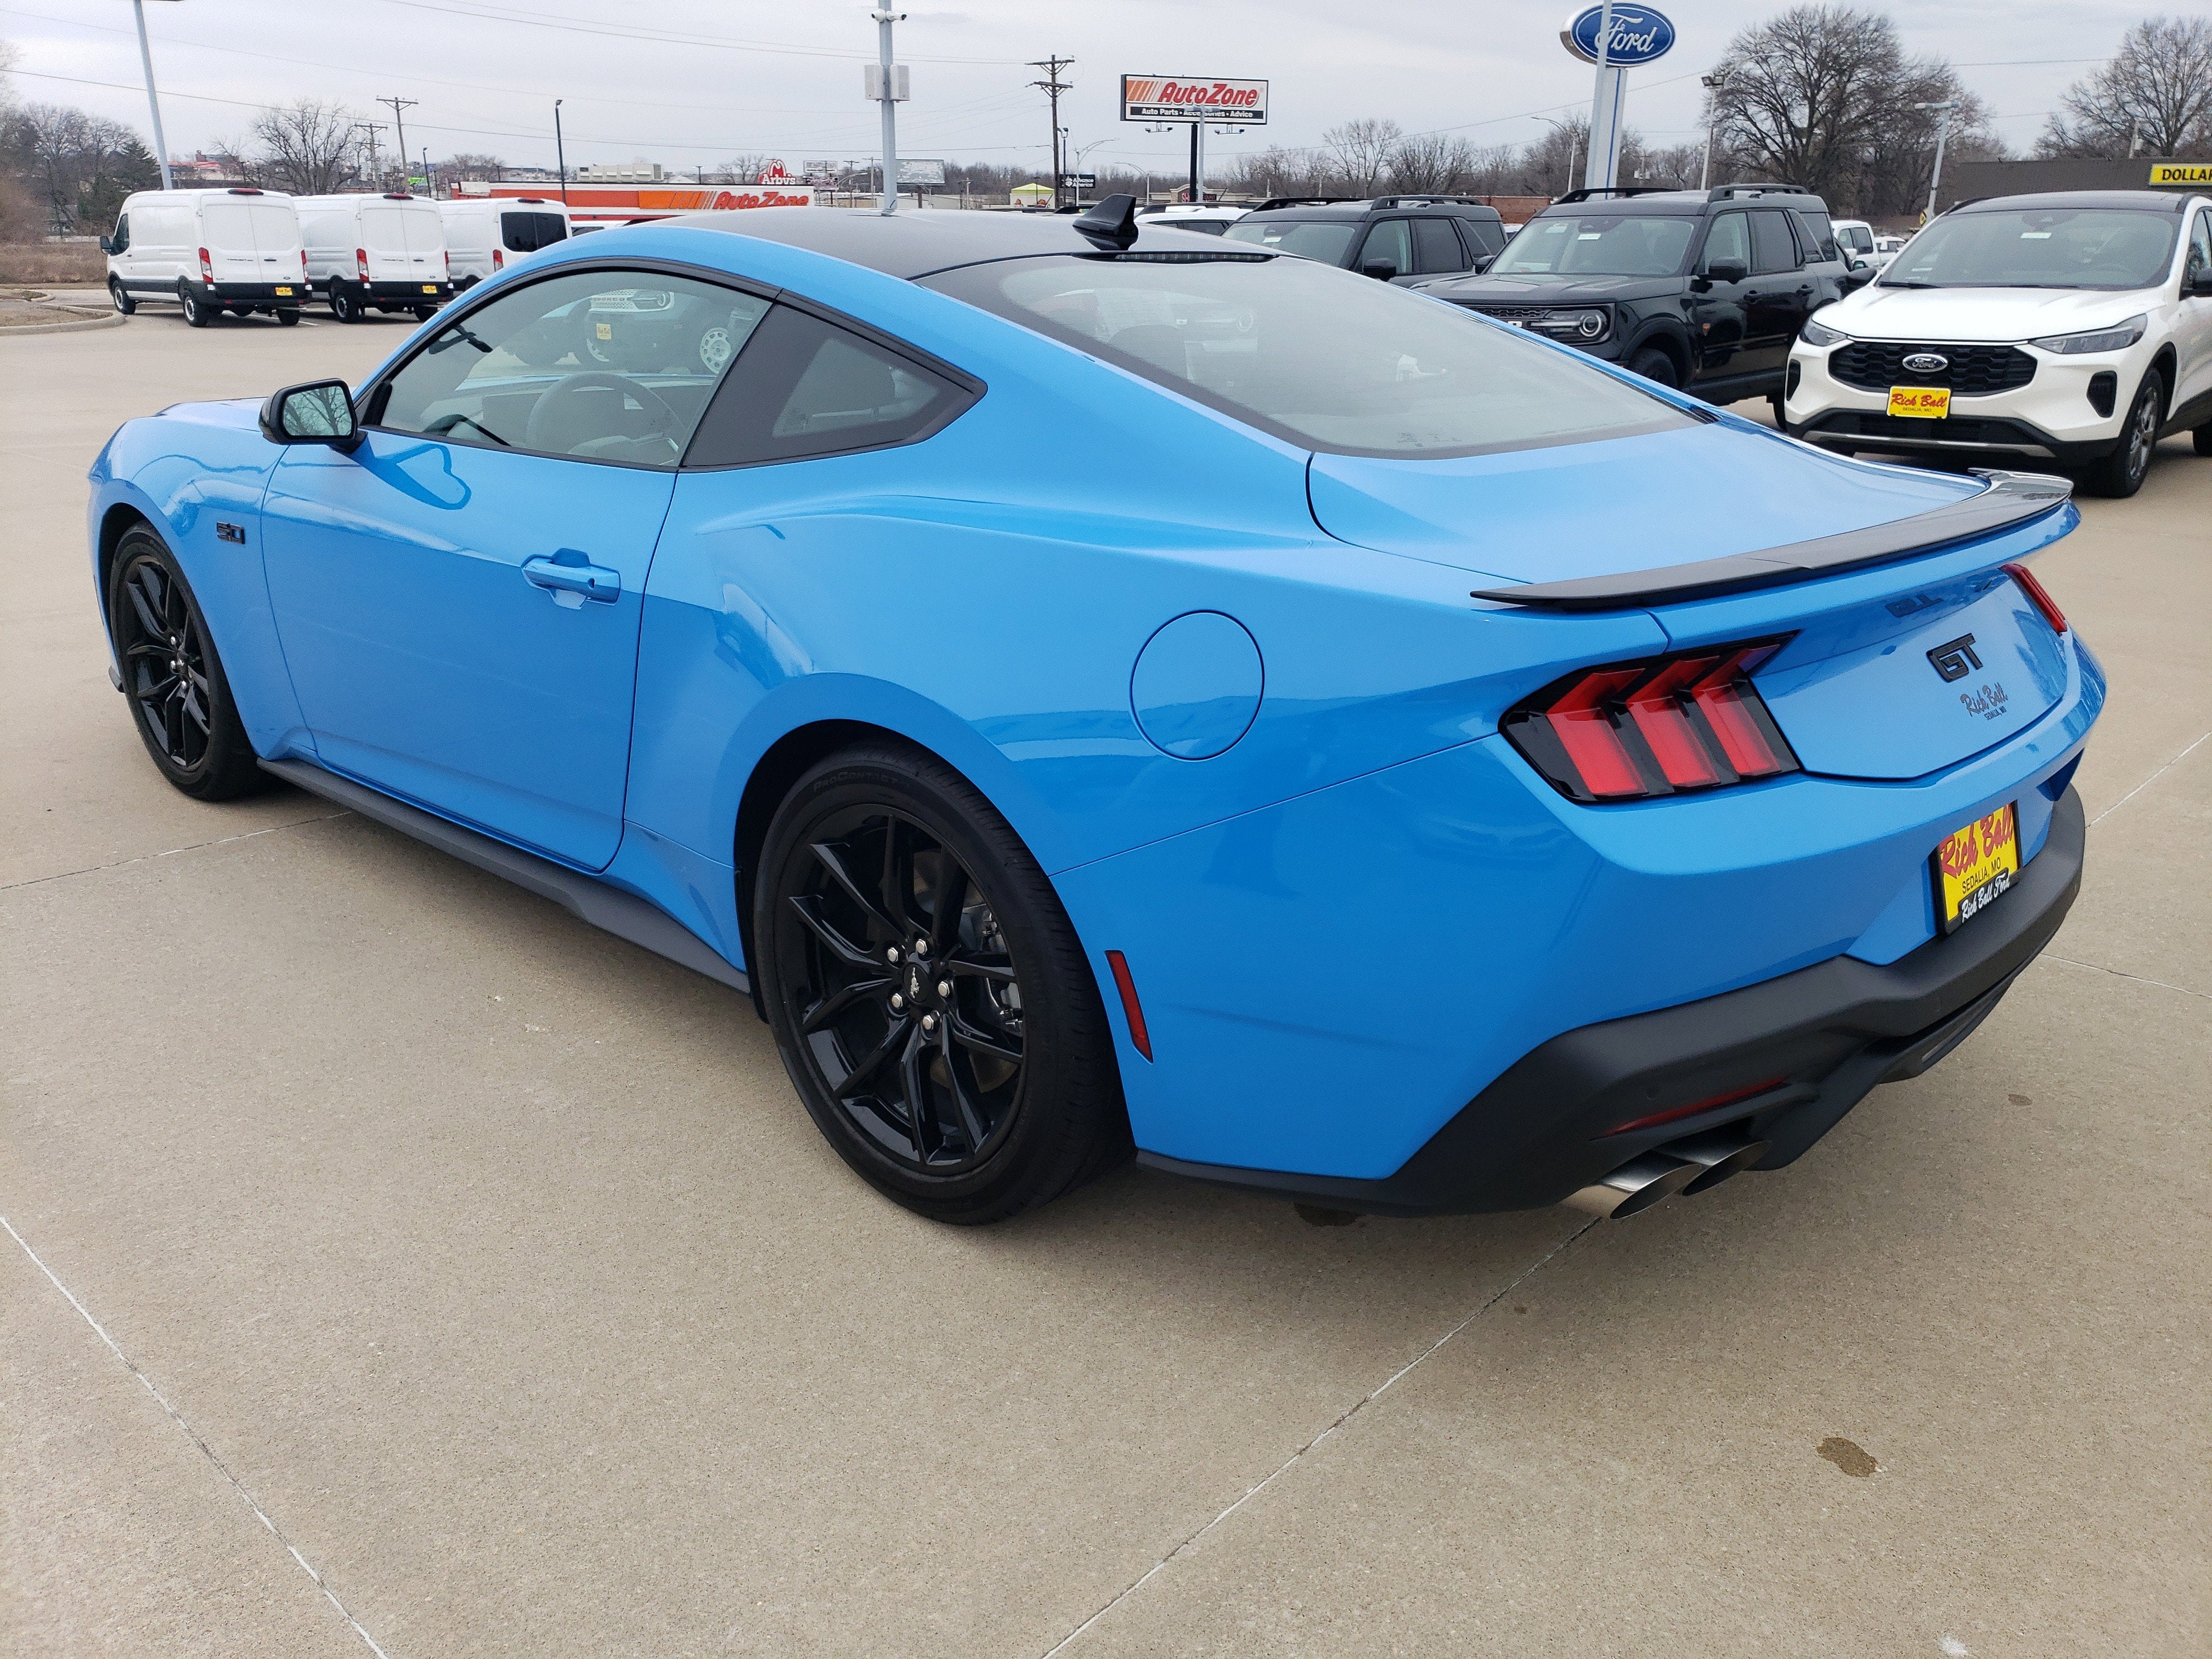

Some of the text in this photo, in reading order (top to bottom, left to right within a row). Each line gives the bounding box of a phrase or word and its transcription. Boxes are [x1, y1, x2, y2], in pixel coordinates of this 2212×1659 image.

[1594, 14, 1657, 52] Ford
[1158, 82, 1258, 106] AutoZone
[713, 192, 809, 210] AutoZone
[1912, 357, 1937, 369] Ford
[1891, 393, 1948, 408] Rich Ball
[217, 522, 245, 545] 5.0
[1926, 633, 1983, 683] GT
[1960, 681, 2008, 717] Rich Ball
[1938, 804, 2013, 879] Rich Ball
[1962, 856, 2001, 894] SEDALIA, MO
[1961, 873, 2010, 924] Rich Ball Ford
